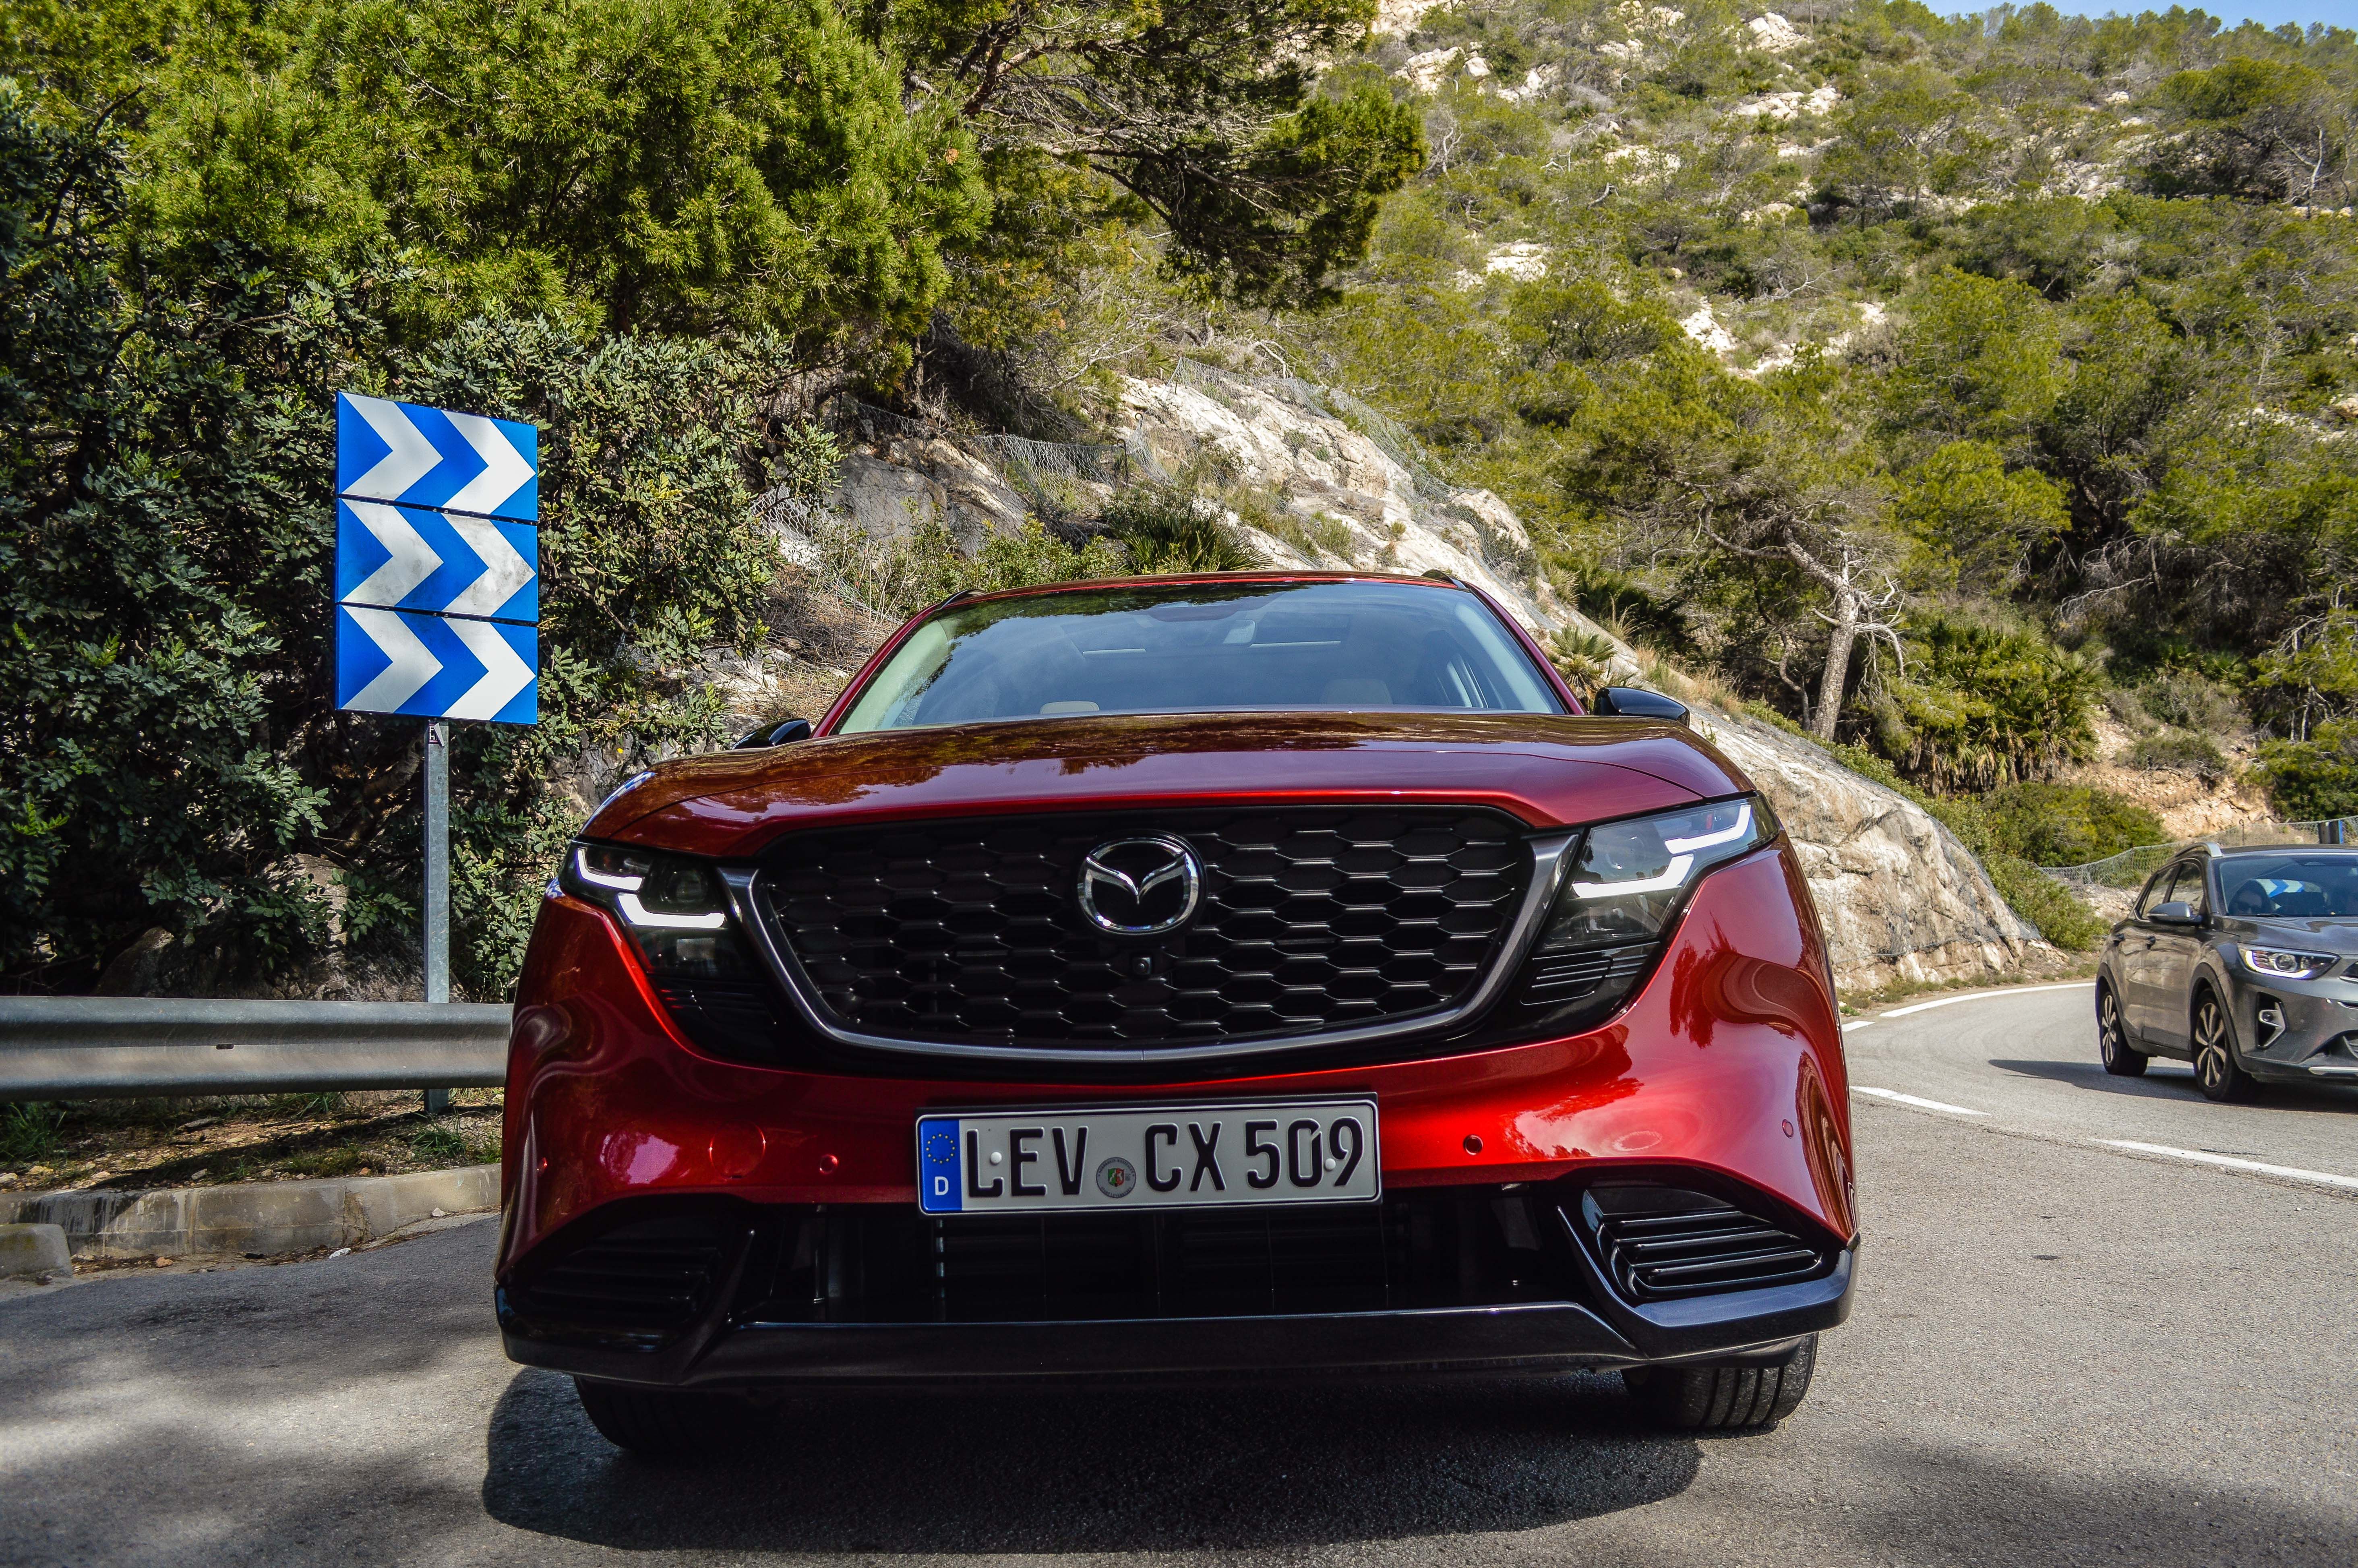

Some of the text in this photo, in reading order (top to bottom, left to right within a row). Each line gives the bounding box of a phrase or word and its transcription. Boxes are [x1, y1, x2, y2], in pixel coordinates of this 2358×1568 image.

[966, 1116, 1363, 1198] LEV CX 509
[935, 1176, 949, 1195] D
